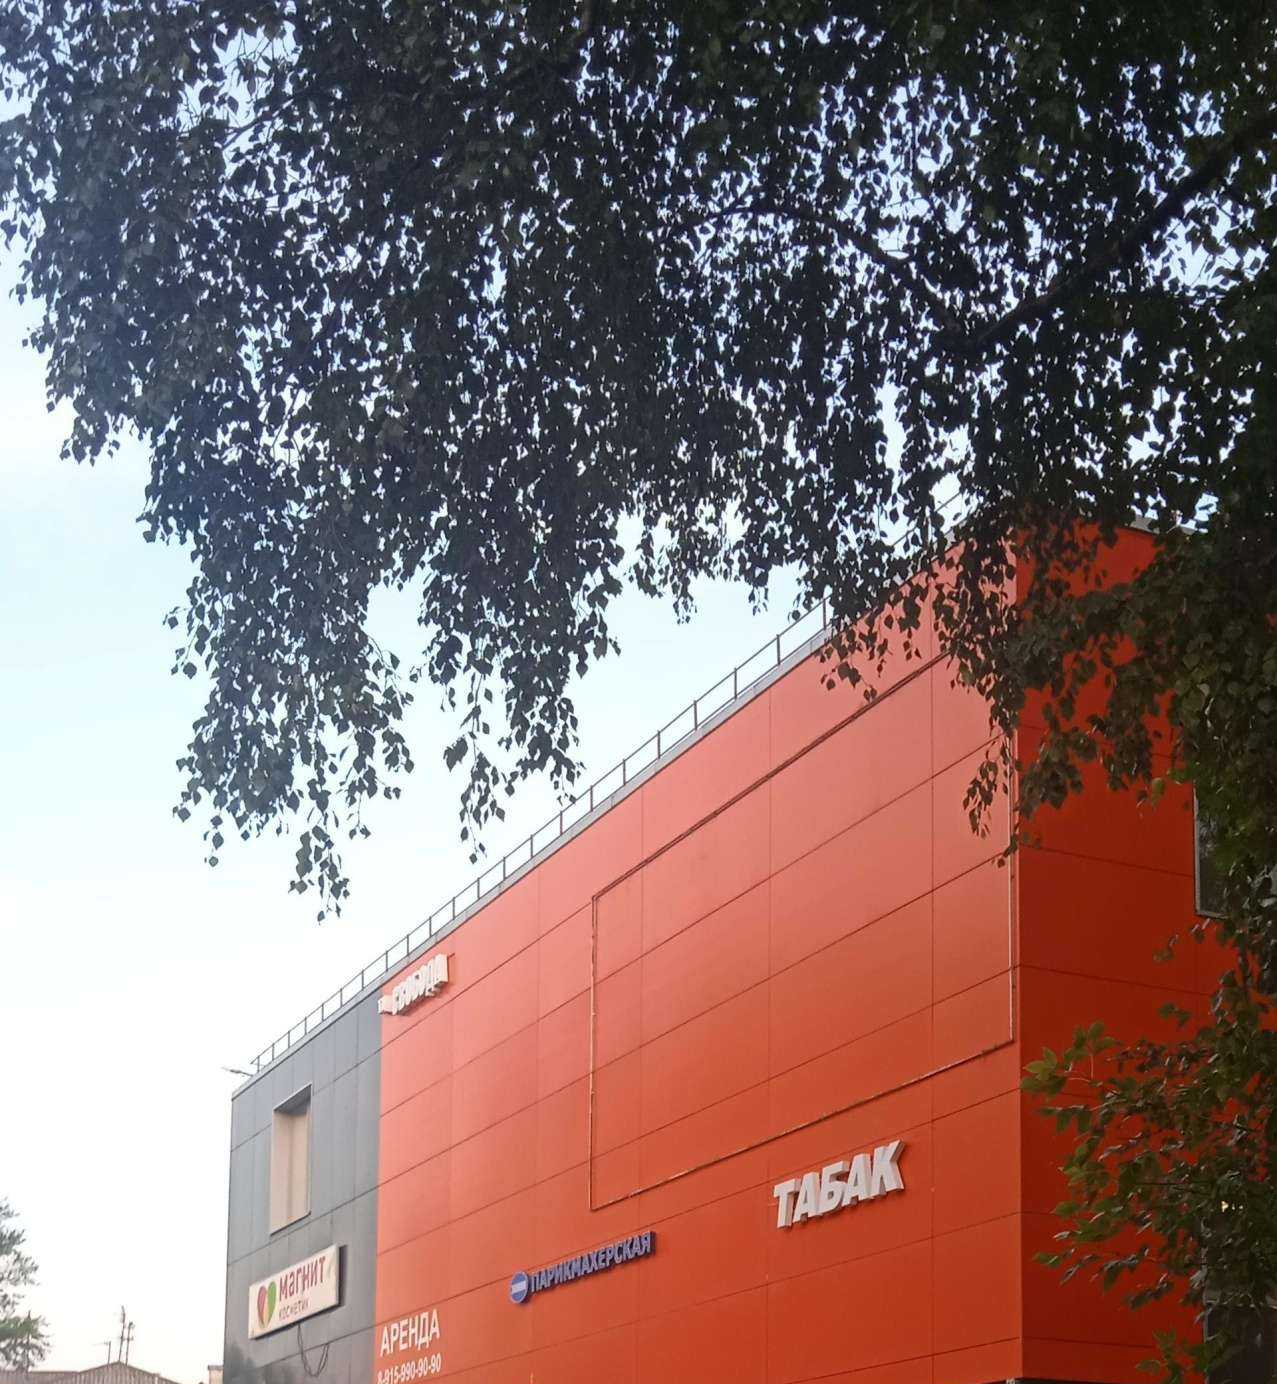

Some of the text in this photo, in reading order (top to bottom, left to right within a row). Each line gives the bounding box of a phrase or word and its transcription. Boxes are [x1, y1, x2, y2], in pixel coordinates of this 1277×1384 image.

[773, 1139, 905, 1228] ТАБАК
[530, 1232, 655, 1293] ПАРИКМАХЕРСКАЯ
[379, 1308, 440, 1357] АРЕНДА
